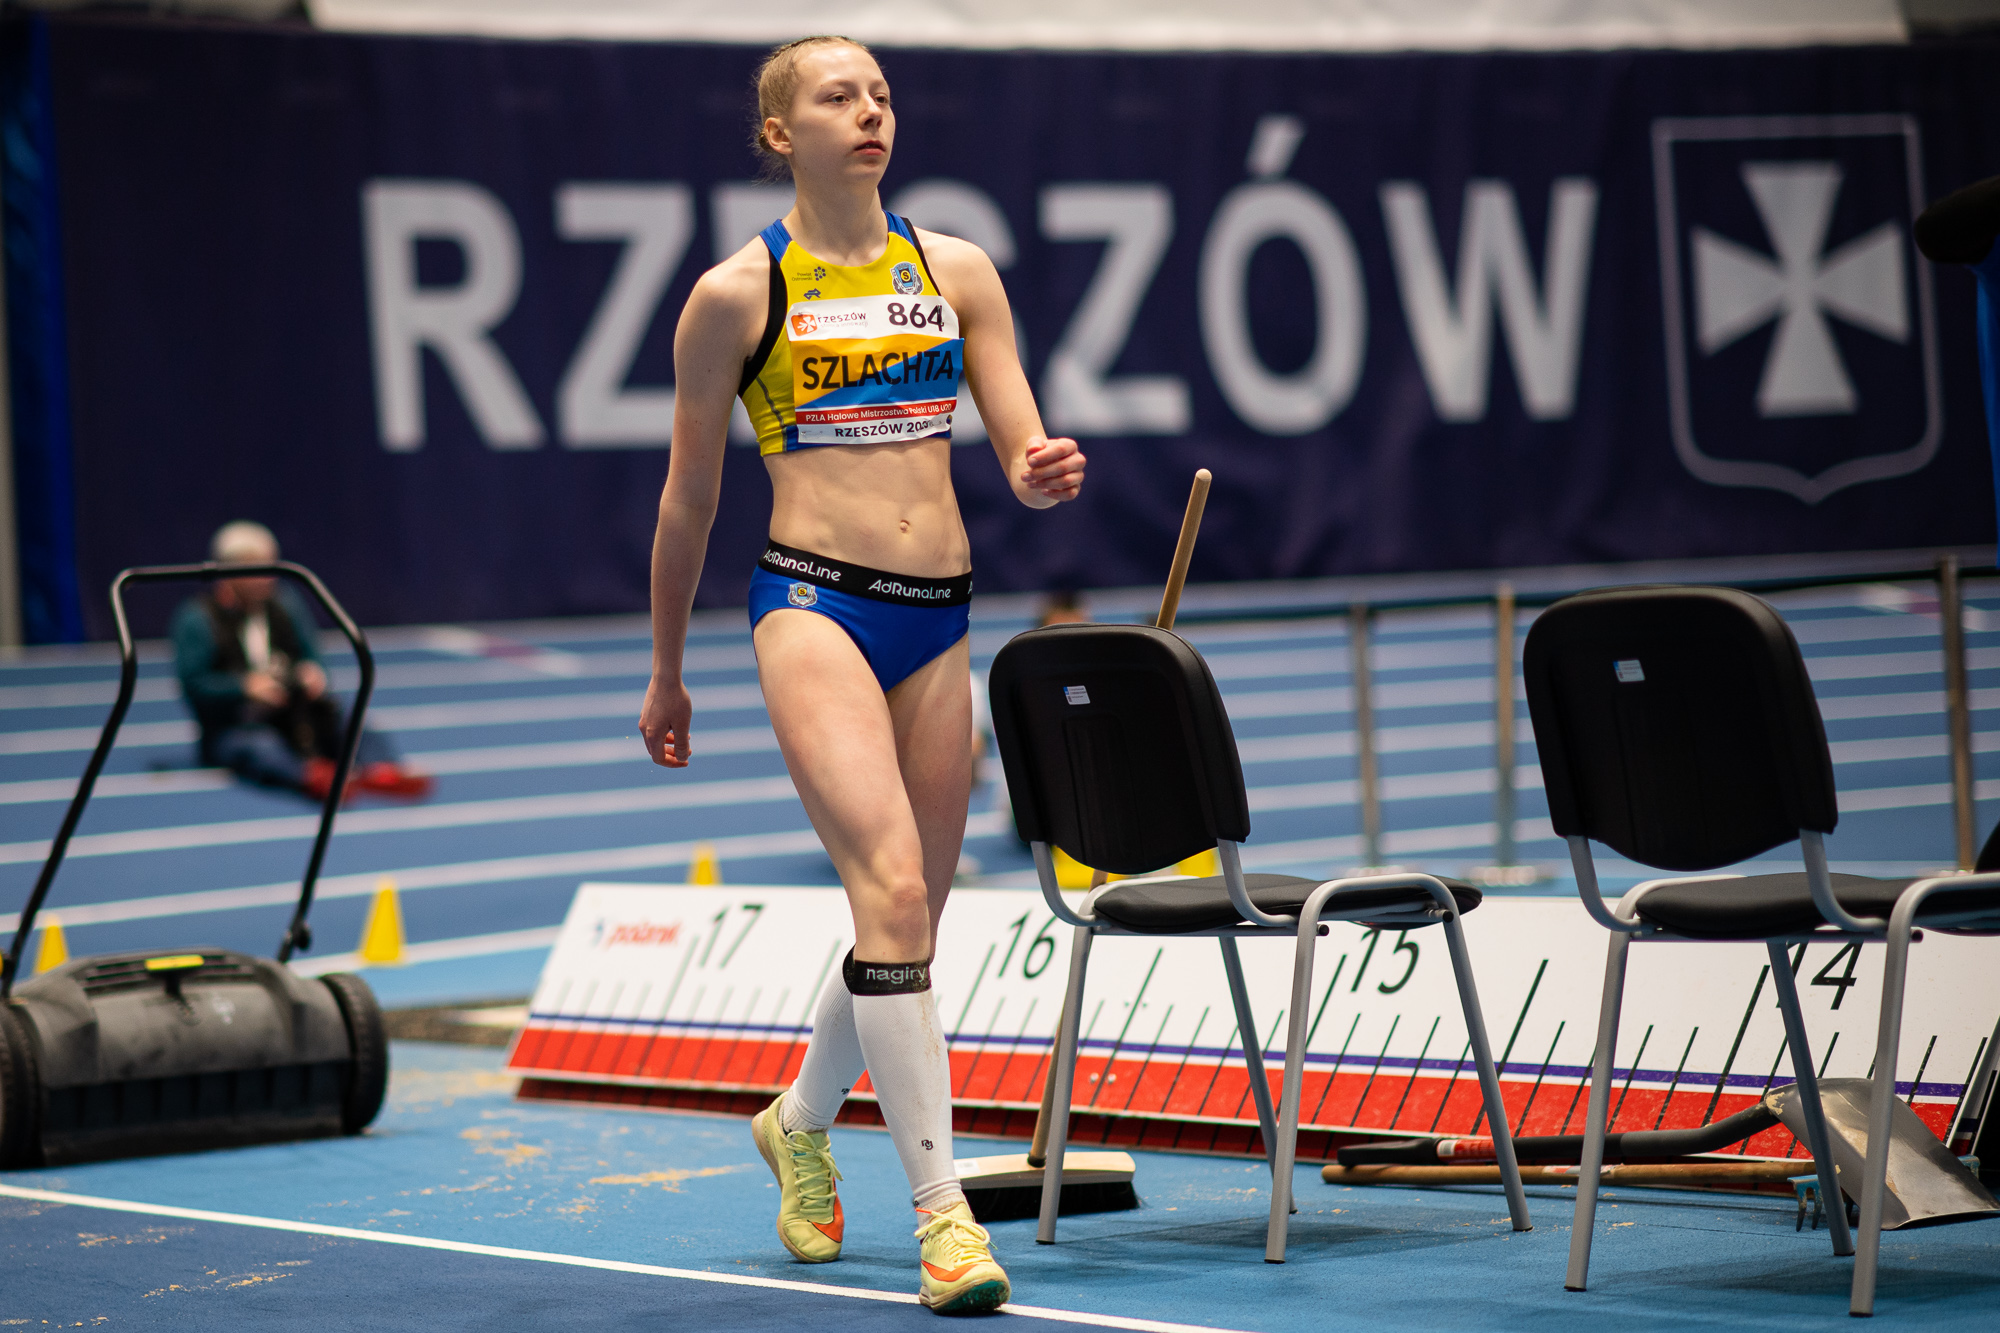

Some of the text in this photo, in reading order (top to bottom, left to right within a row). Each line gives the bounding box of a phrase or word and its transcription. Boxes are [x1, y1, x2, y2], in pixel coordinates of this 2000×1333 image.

[817, 312, 867, 323] rzeszów
[887, 302, 945, 332] 864
[802, 350, 954, 390] SZLACHTA
[805, 414, 826, 422] PZLA
[827, 411, 859, 421] Halowe
[860, 407, 909, 418] Mistrzostwa
[909, 405, 927, 415] Polski
[927, 404, 940, 413] U18
[835, 421, 903, 437] RZESZÓW
[763, 549, 842, 582] AdRunaLine
[868, 579, 952, 599] AdRunaLine
[699, 902, 764, 968] 17
[999, 907, 1057, 979] 16
[866, 966, 926, 985] nagiry
[1350, 929, 1420, 994] 15
